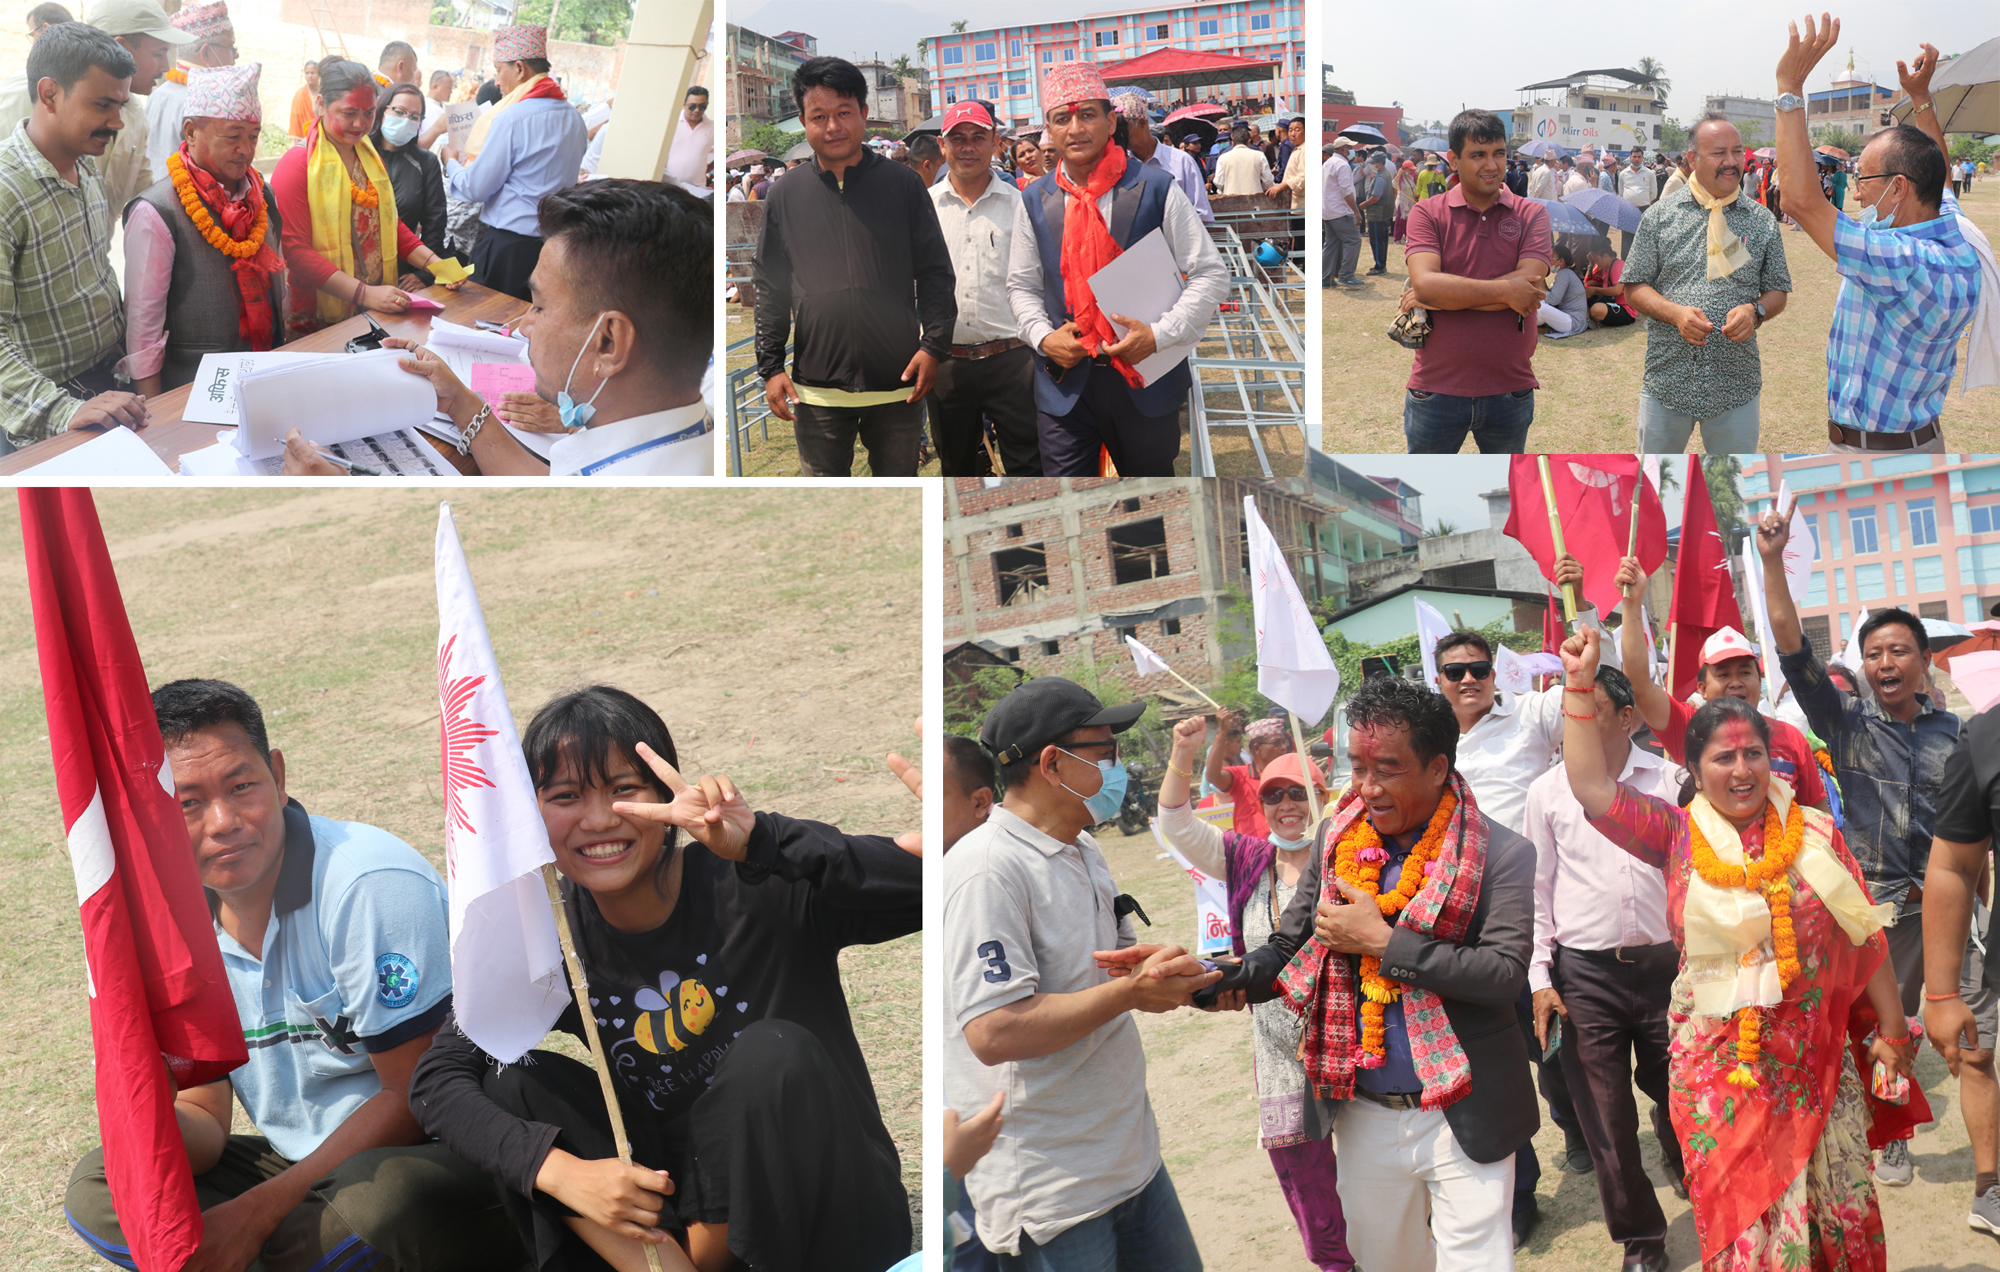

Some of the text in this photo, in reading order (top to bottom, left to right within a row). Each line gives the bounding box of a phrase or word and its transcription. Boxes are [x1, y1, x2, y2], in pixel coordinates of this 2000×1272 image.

[1562, 126, 1599, 137] Mirr Oils
[208, 367, 230, 403] अफिस
[977, 940, 1011, 983] 3
[646, 1076, 679, 1094] BEE
